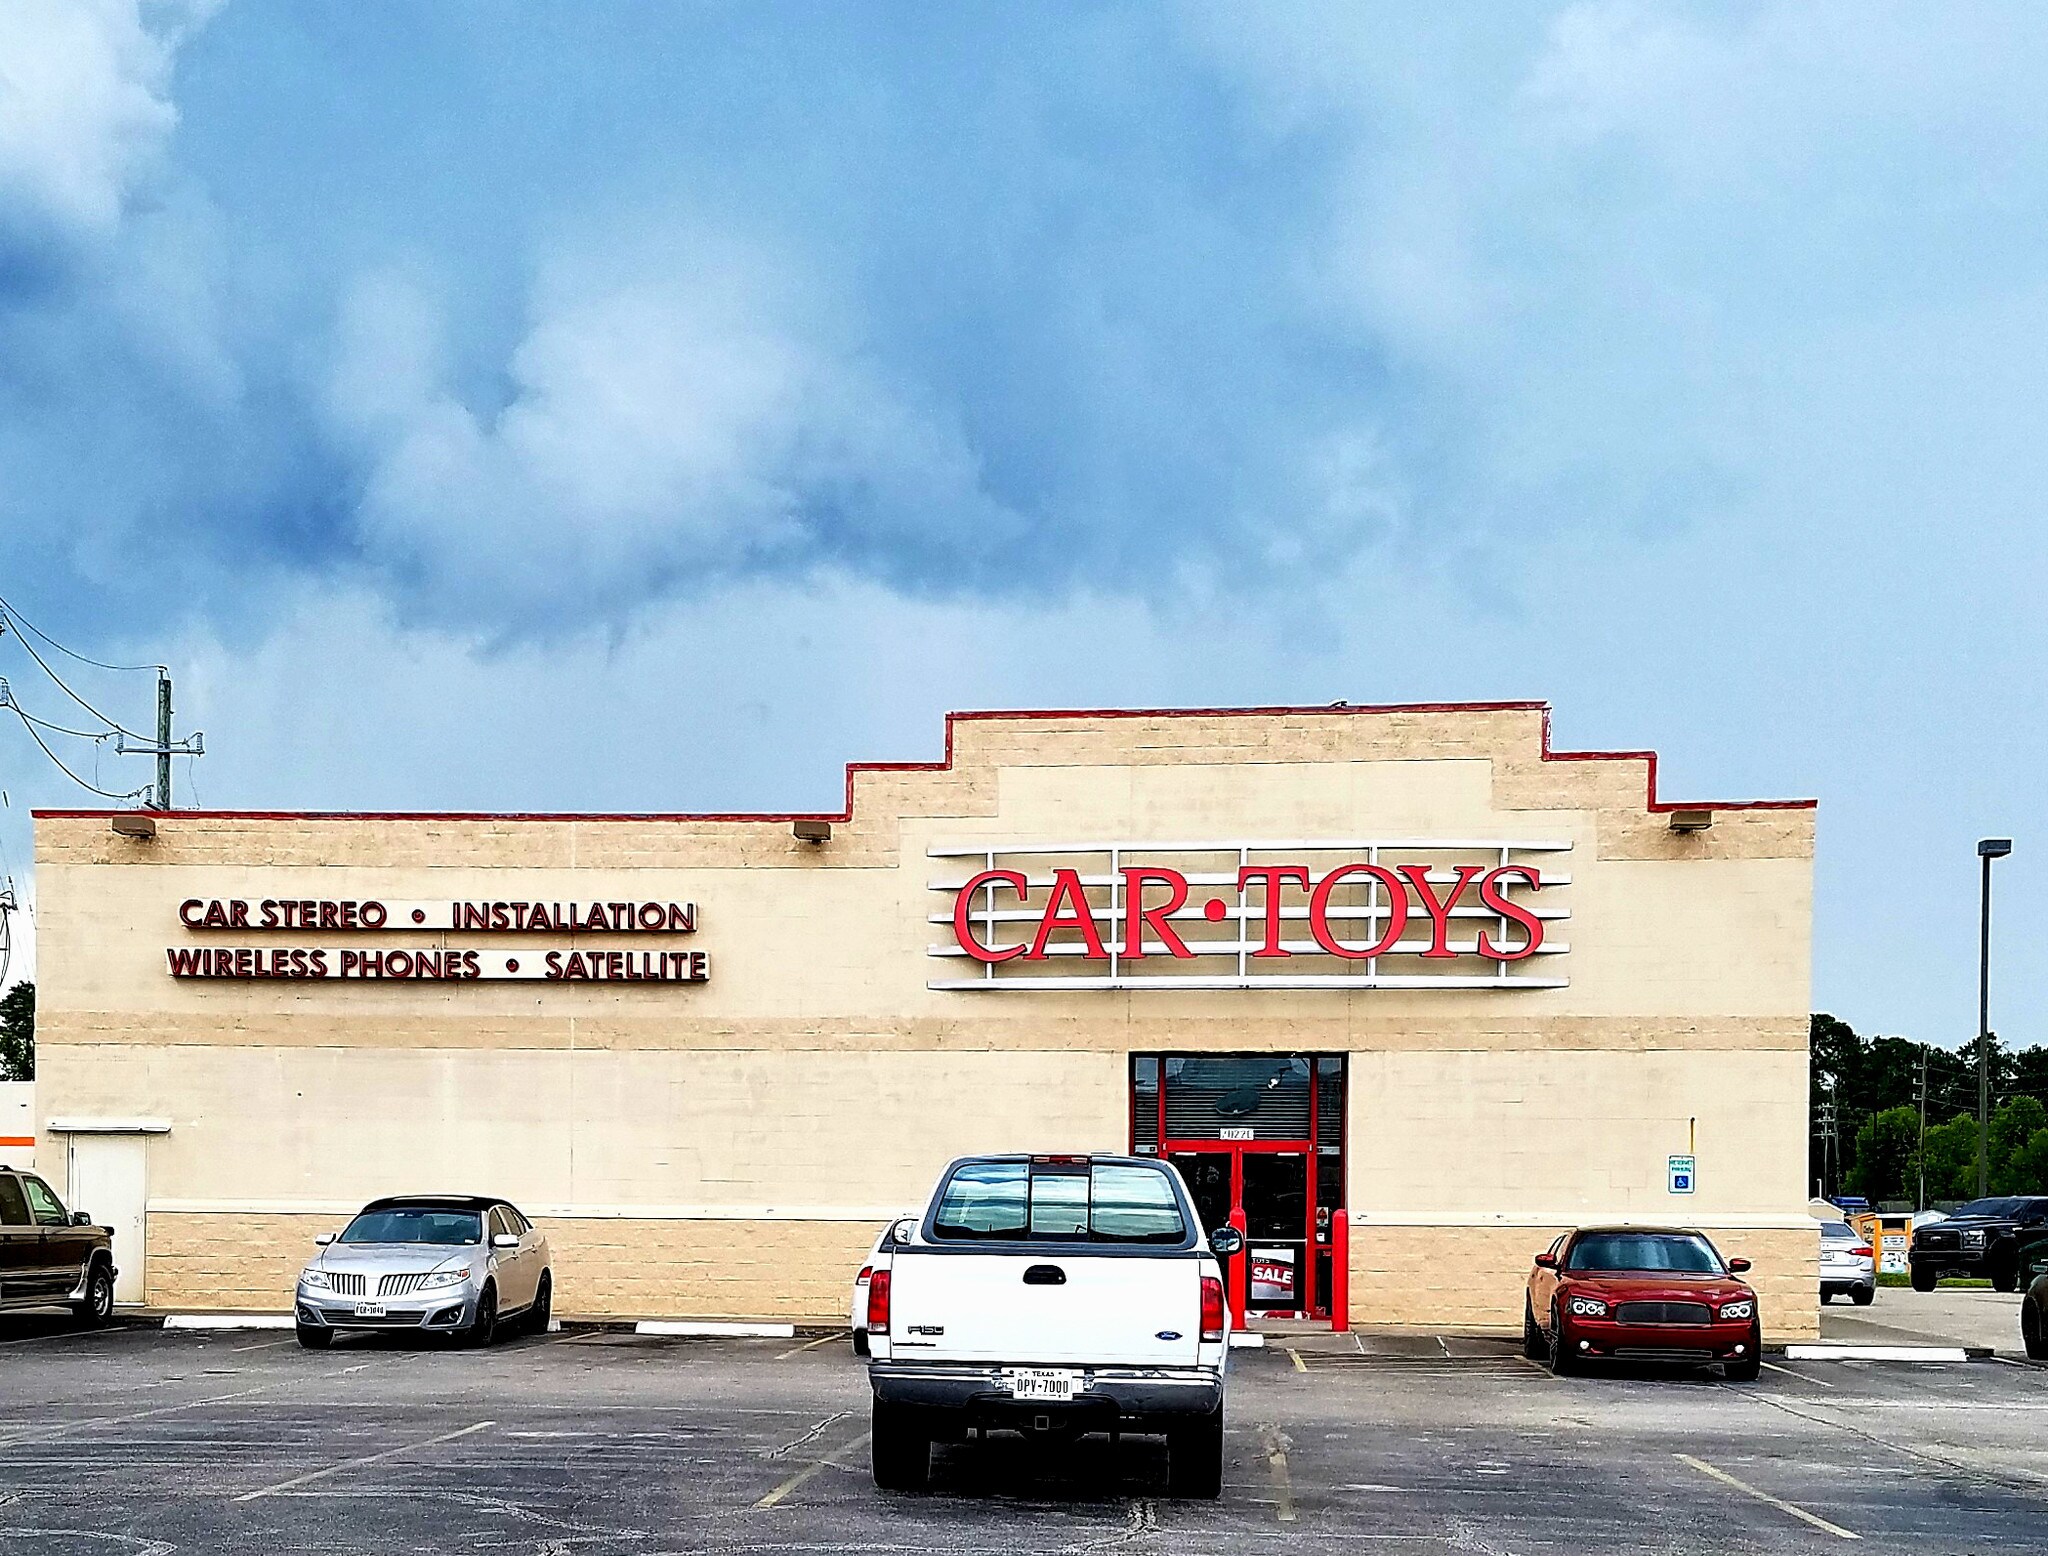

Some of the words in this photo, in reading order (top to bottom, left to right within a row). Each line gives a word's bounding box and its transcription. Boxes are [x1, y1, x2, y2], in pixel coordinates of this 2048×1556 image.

[179, 899, 250, 928] CAR
[260, 899, 387, 929] STEREO
[451, 901, 694, 931] INSTALLATION
[953, 867, 1196, 962] CAR
[1236, 863, 1544, 961] TOYS
[167, 948, 328, 977] WIRELESS
[340, 950, 481, 979] PHONES
[544, 951, 707, 980] SATELLITE
[1253, 1267, 1293, 1284] SALE
